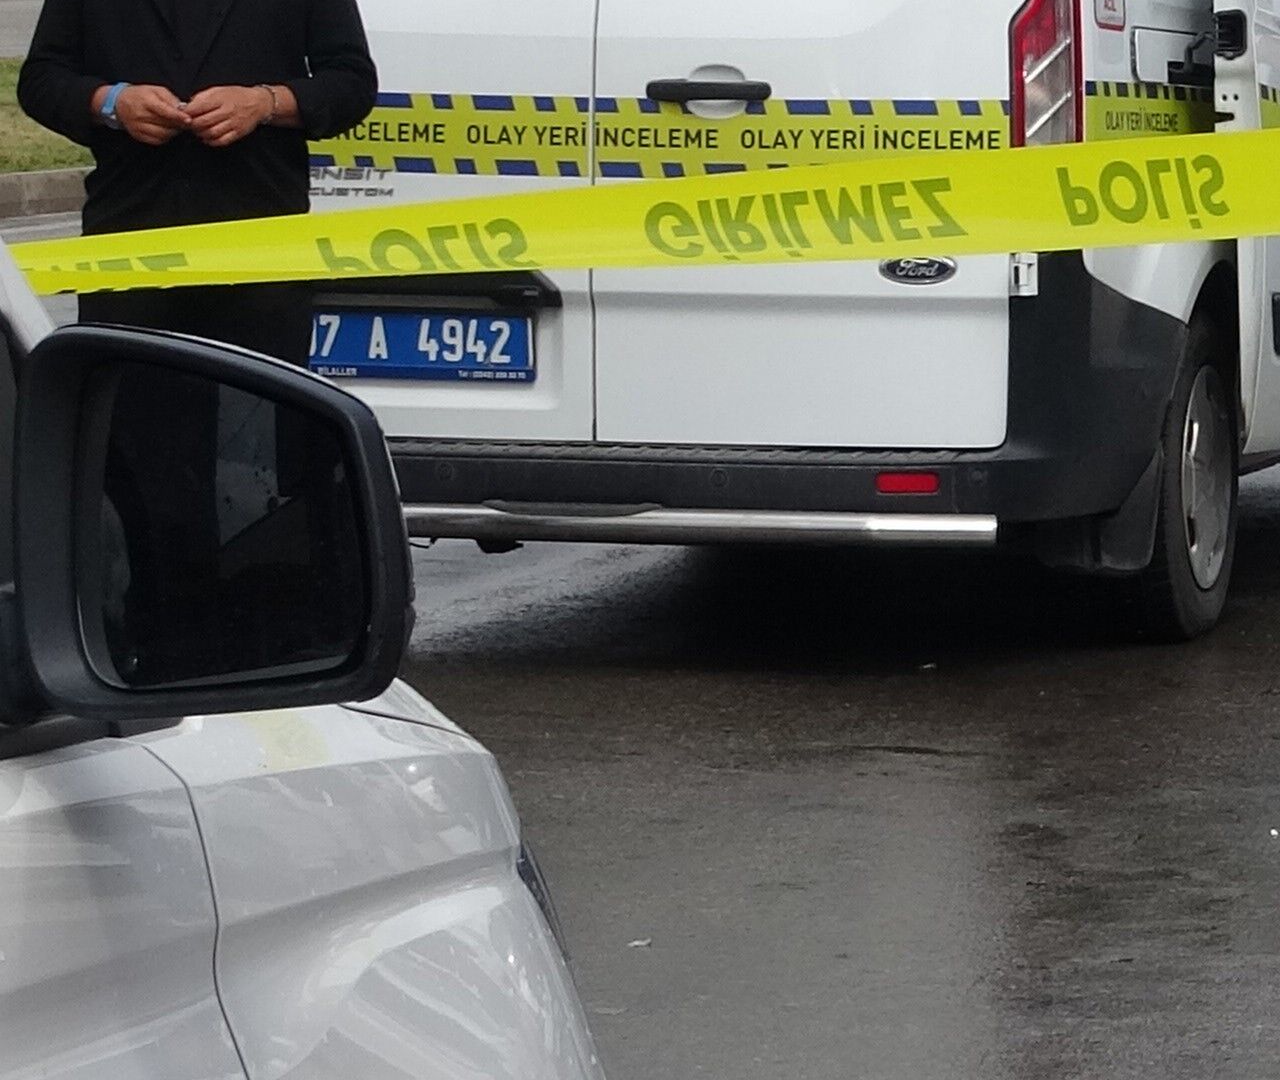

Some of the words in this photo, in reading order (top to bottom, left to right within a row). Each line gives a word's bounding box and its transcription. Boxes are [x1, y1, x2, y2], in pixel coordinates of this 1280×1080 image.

[336, 121, 446, 144] NCELEME
[466, 125, 527, 146] OLAY
[533, 121, 587, 147] YERİ
[740, 129, 804, 150] OLAY
[810, 124, 866, 150] YERİ
[874, 124, 1001, 151] İNCELEME
[894, 257, 941, 281] Ford
[368, 316, 388, 360] A
[417, 318, 511, 364] 4942
